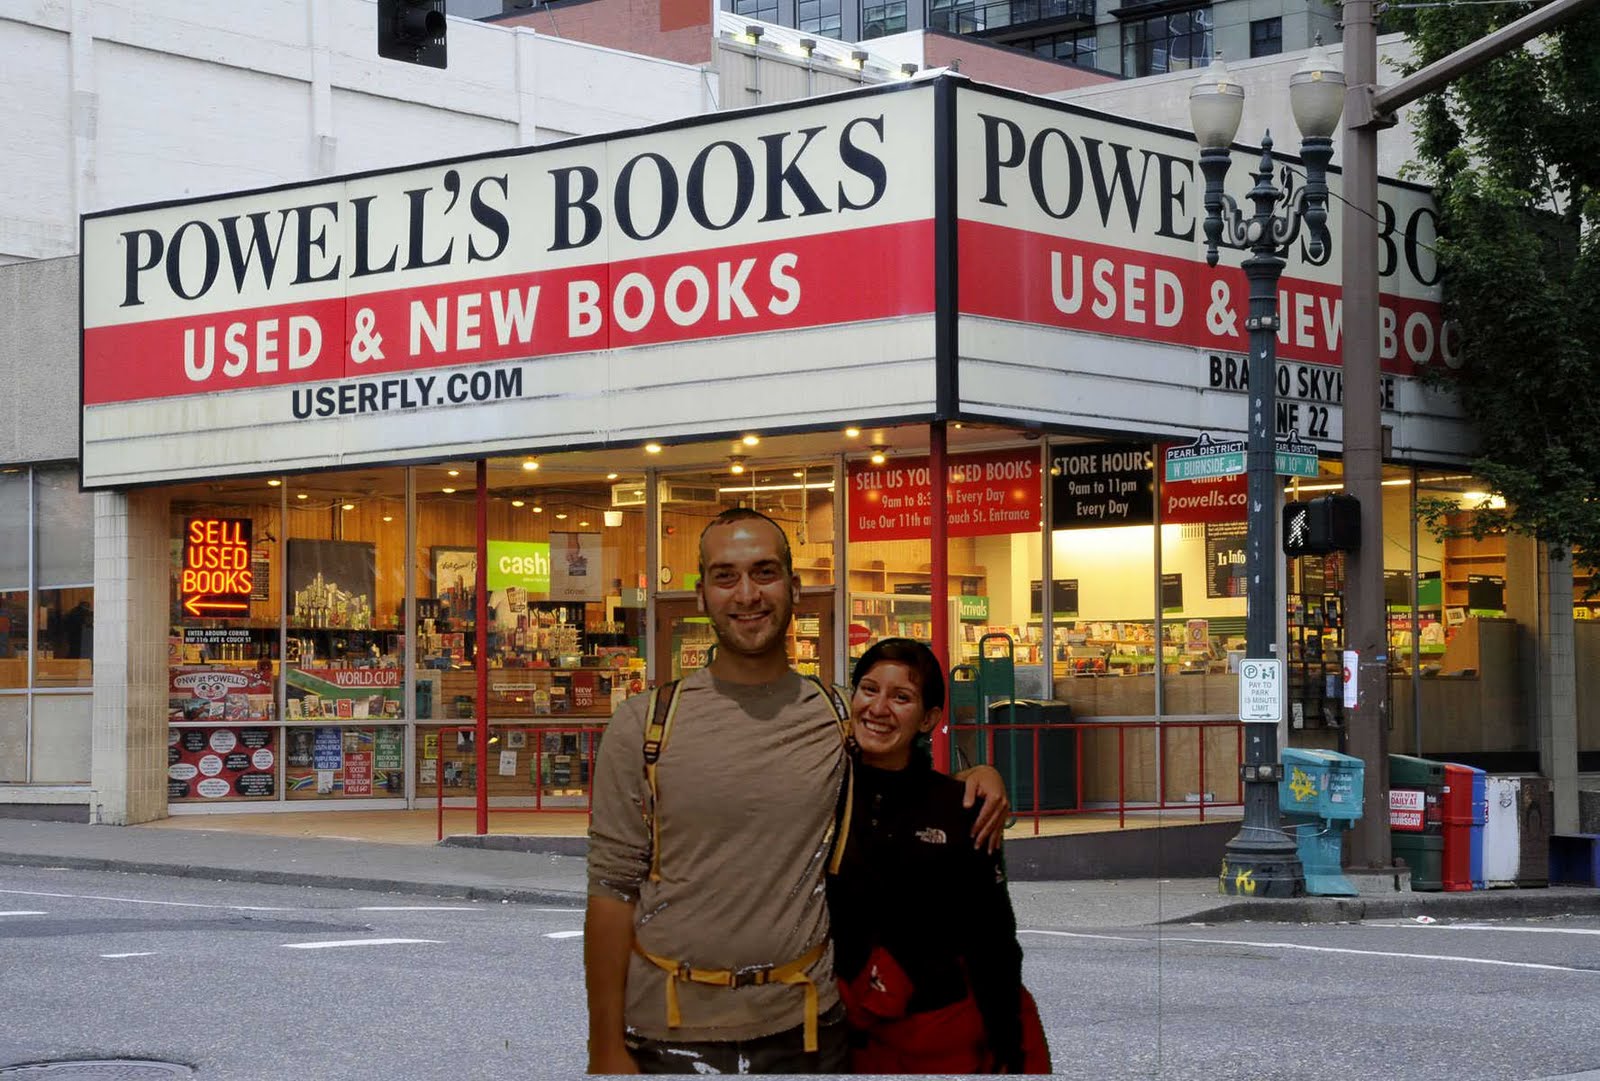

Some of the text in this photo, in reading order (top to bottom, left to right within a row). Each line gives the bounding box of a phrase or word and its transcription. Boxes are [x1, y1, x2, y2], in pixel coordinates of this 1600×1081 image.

[977, 113, 1332, 267] POWE'S
[119, 114, 887, 307] POWELL'S BOOKS
[1051, 251, 1184, 327] USED
[1206, 280, 1239, 337] &
[184, 252, 801, 382] USED & NEW BOOKS
[1209, 355, 1291, 396] BRAO
[292, 366, 523, 419] USERFLY.COM
[1276, 402, 1329, 438] NE 22
[1168, 442, 1242, 459] PEARL DISTRICT
[1275, 442, 1316, 455] EARL DISTRICT
[856, 460, 1032, 490] SELL US YOU USED BOOKS
[1054, 451, 1151, 476] STORE HOURS
[1173, 461, 1182, 476] W
[1184, 457, 1225, 476] BURNSIDE
[1304, 458, 1315, 474] AV
[882, 495, 901, 508] 9am
[905, 495, 914, 507] to
[956, 490, 983, 506] Every
[986, 488, 1005, 504] Day
[1068, 479, 1136, 496] 9am to 11pm
[1077, 500, 1129, 518] Every Day
[1168, 490, 1247, 513] powells.co
[859, 516, 876, 530] Use
[879, 515, 895, 528] Our
[900, 513, 920, 527] 11th
[973, 509, 986, 522] St.
[989, 507, 1030, 522] Entrance
[189, 520, 247, 545] SELL
[190, 545, 248, 570] USED
[183, 569, 252, 594] BOOKS
[959, 600, 987, 617] Arrivals
[176, 675, 197, 685] PNW
[207, 674, 247, 686] POWELL'S
[335, 671, 397, 685] WORLD CUP!
[1391, 797, 1408, 805] DAILY
